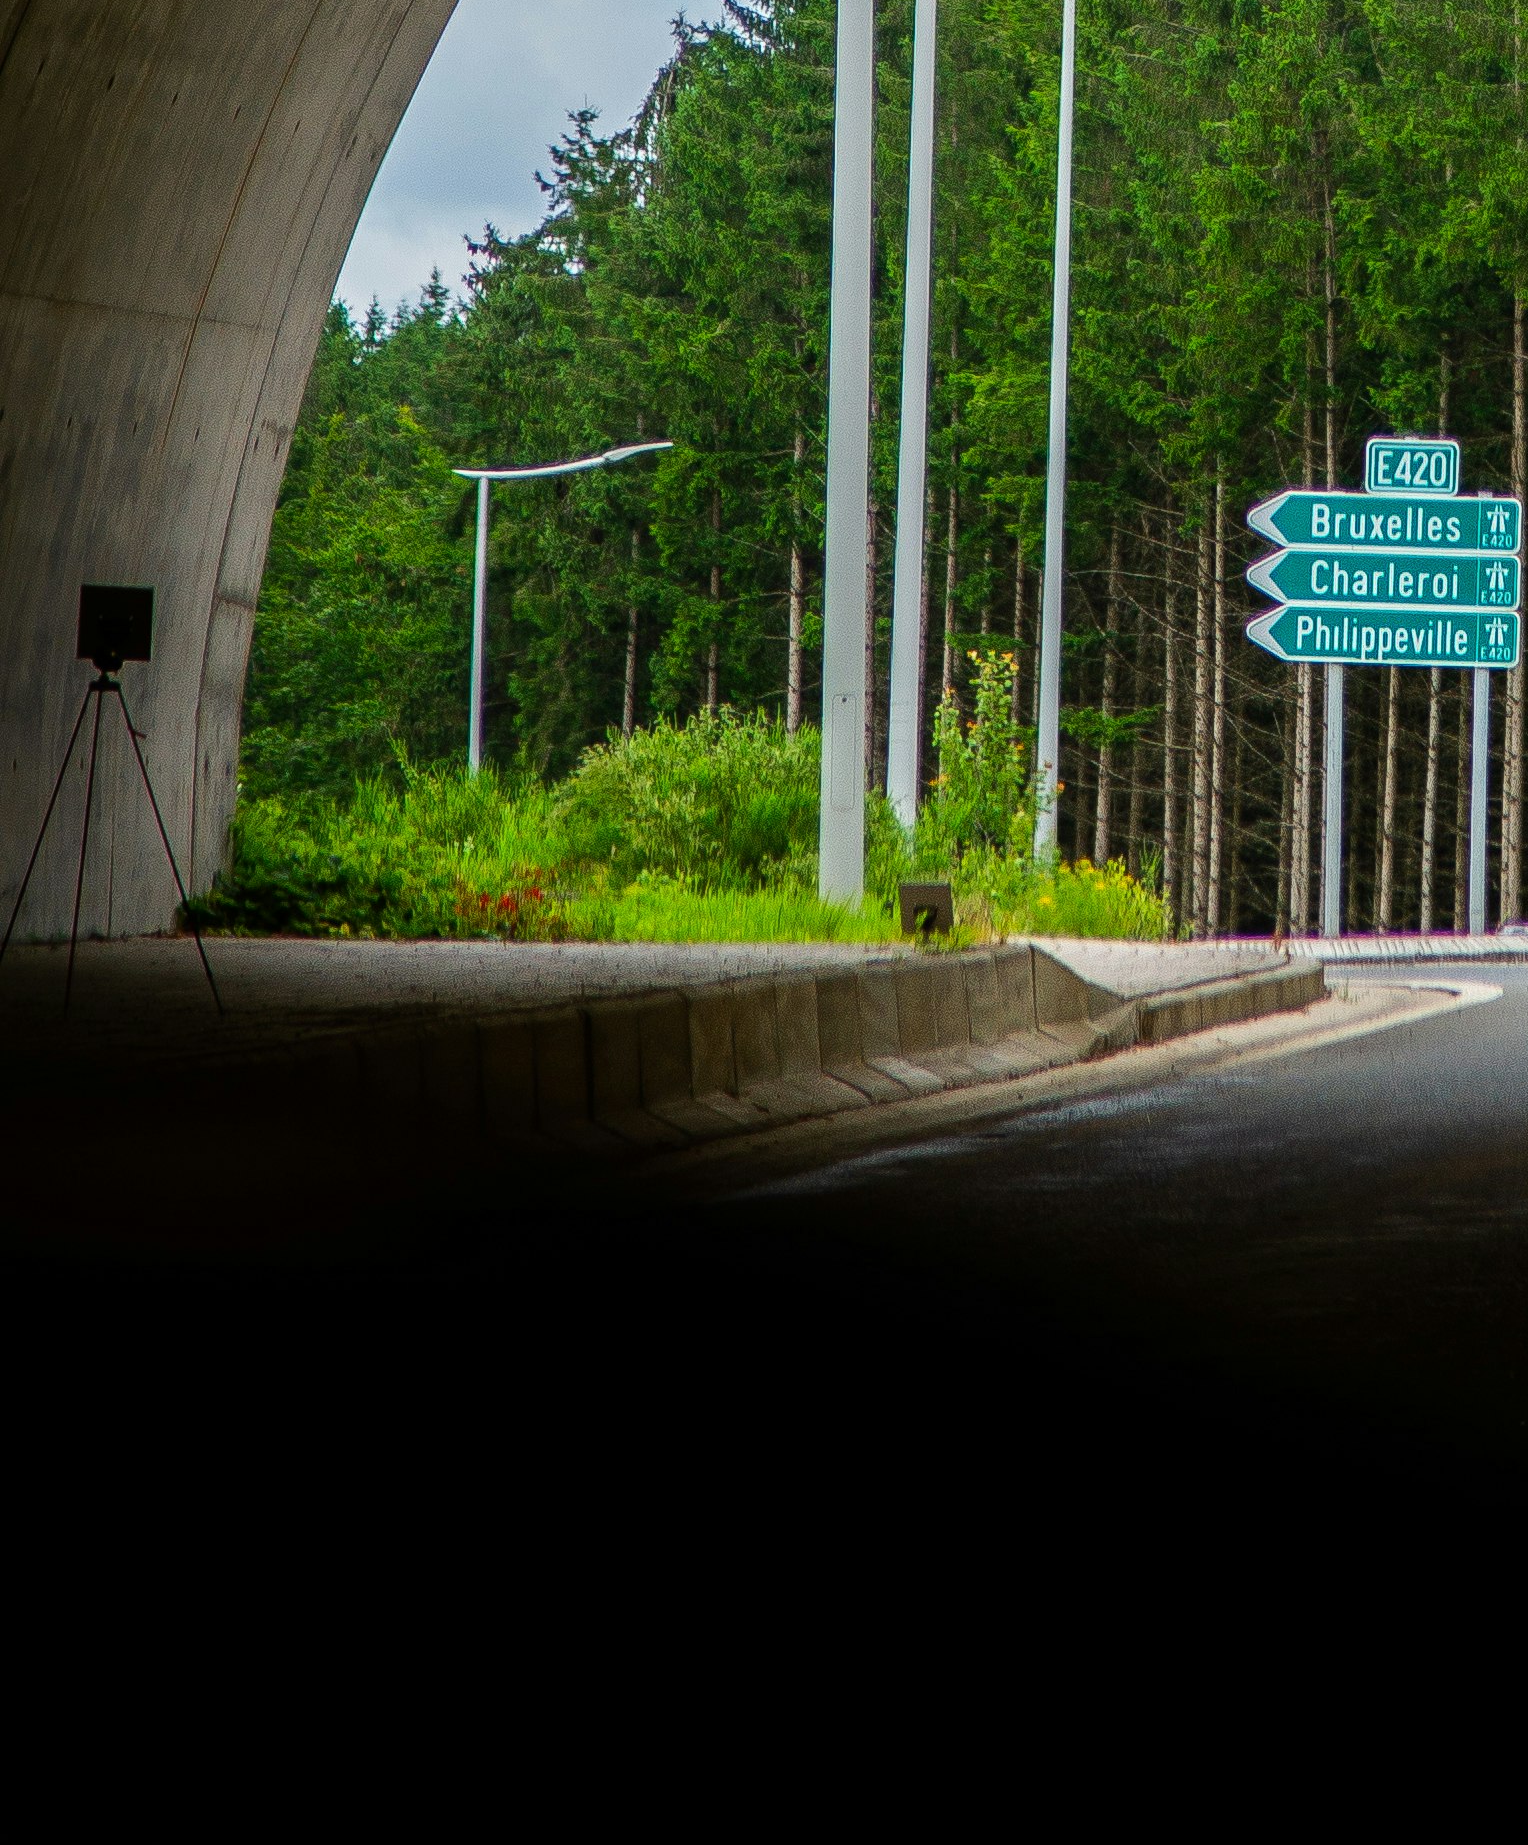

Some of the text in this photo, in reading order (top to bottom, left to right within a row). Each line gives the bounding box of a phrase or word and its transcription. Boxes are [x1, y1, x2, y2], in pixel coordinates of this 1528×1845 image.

[1377, 450, 1447, 486] E420
[1311, 503, 1461, 542] Bruxelles
[1482, 534, 1512, 548] E420
[1310, 559, 1458, 599] Charleroi
[1481, 591, 1511, 604] E420
[1296, 615, 1468, 661] Philippeville
[1480, 647, 1511, 660] E420
